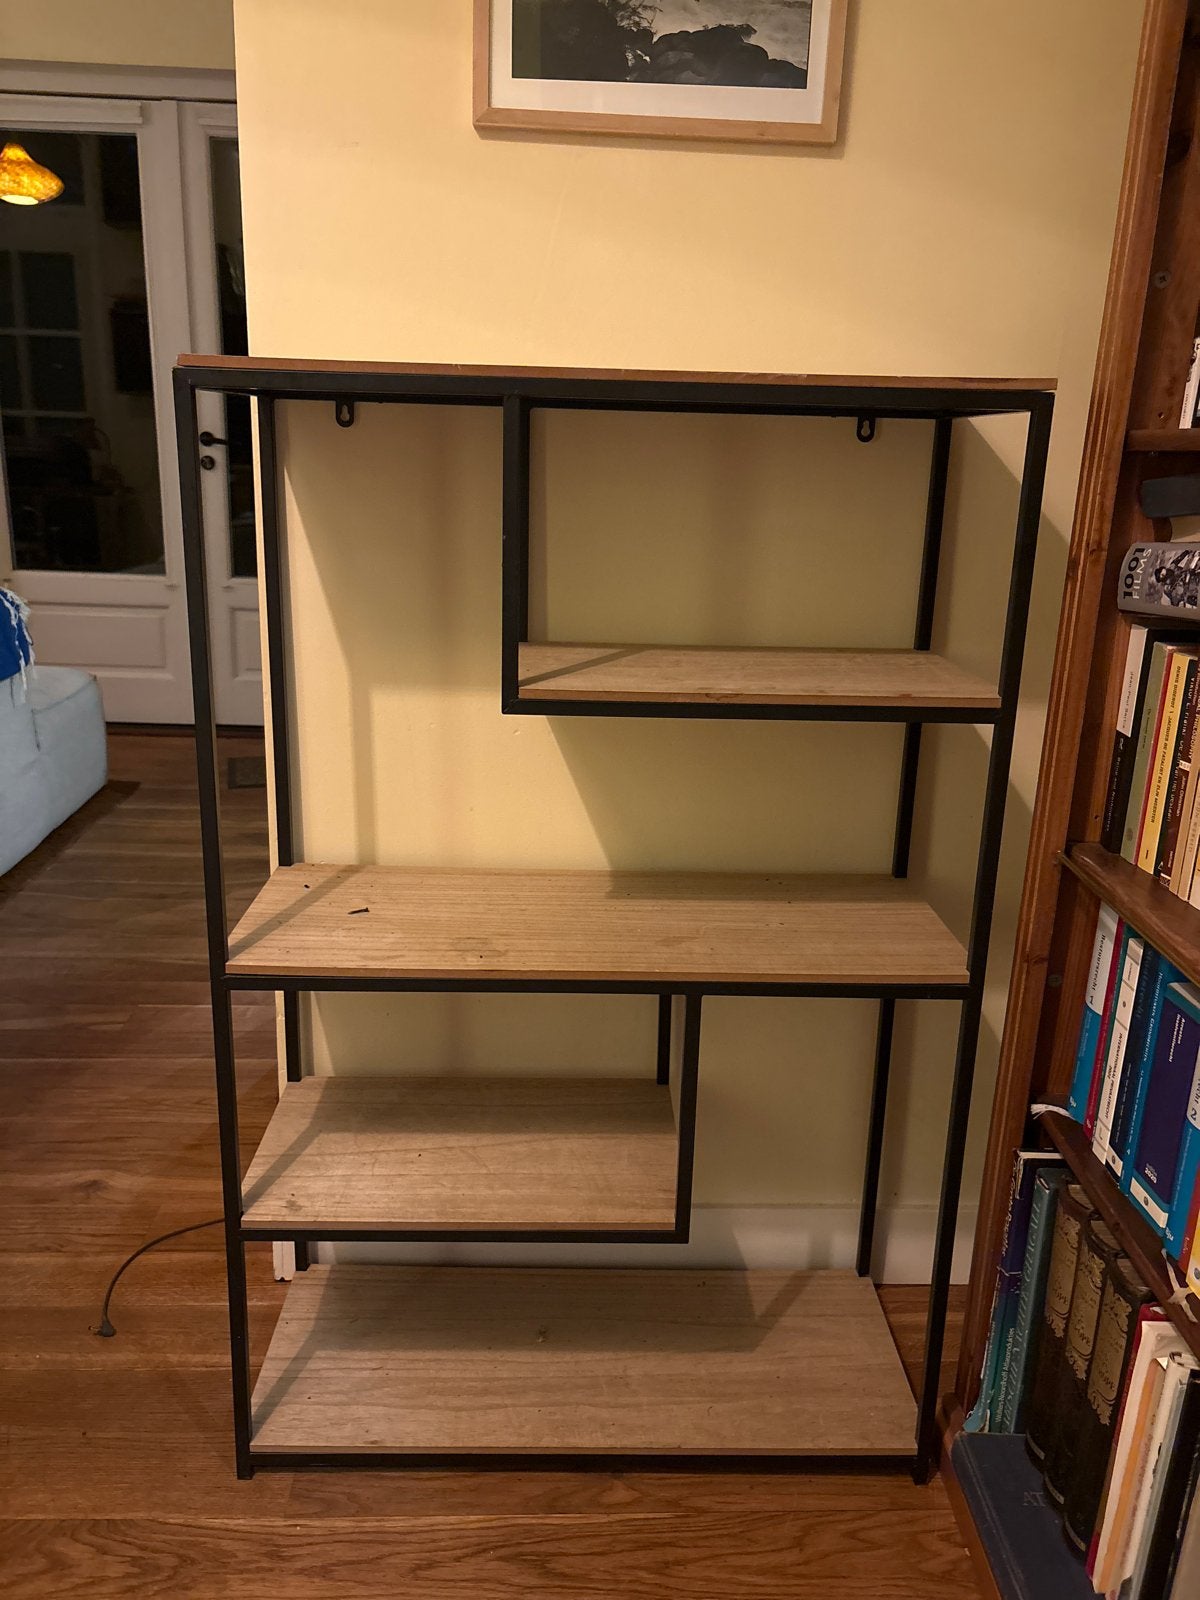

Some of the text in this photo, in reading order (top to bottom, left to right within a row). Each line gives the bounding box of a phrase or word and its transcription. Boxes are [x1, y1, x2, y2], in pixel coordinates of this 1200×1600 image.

[1123, 547, 1145, 599] 1001
[1132, 548, 1152, 600] FILMS
[1159, 750, 1167, 775] FATALIST
[1150, 797, 1158, 824] MEESTER
[1092, 934, 1106, 991] Bestuursrecht
[1087, 995, 1094, 1006] 1
[1105, 1032, 1123, 1119] INTERNATIONAAL PRIVAATRECHT
[1190, 1108, 1198, 1121] 2
